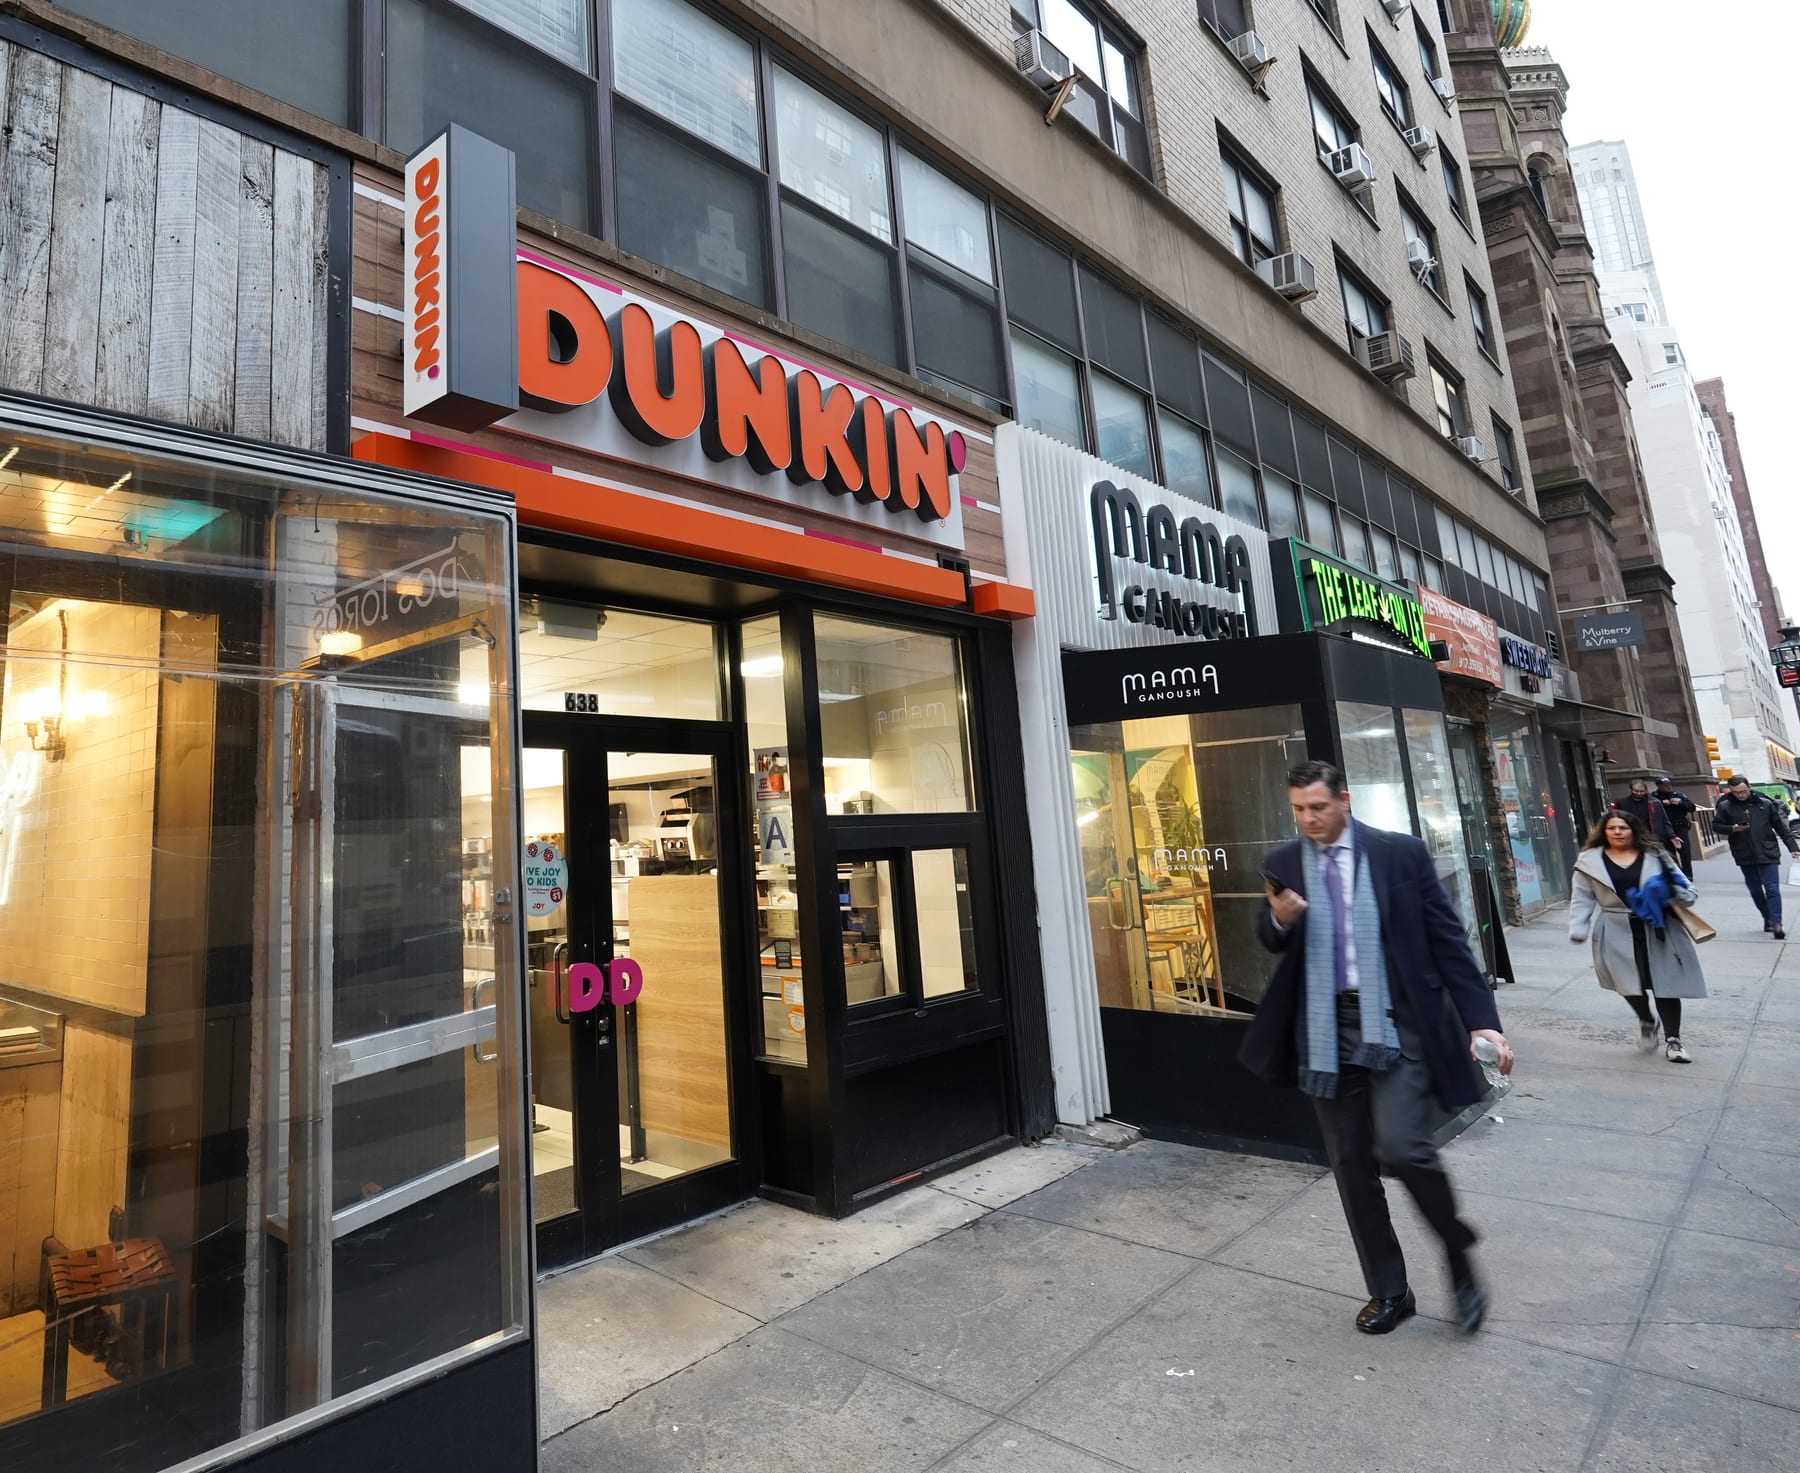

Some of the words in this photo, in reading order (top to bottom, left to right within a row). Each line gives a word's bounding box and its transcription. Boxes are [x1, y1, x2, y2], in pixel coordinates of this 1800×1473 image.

[415, 157, 440, 380] DUNKIN'
[517, 260, 967, 522] DUNKIN'
[1090, 480, 1259, 637] MAMA
[1123, 585, 1247, 639] GANOUSH
[1310, 558, 1348, 627] THE
[1344, 572, 1380, 621] LEAF
[1388, 592, 1409, 638] ON
[1404, 599, 1433, 660] LEX
[1582, 627, 1631, 639] Mulberry
[1122, 664, 1219, 704] MAMA
[1138, 688, 1201, 703] GANOUSH
[565, 692, 599, 712] 638
[765, 816, 788, 850] A
[526, 867, 540, 876] IVE
[542, 867, 561, 876] JOY
[1154, 848, 1228, 871] MAMA
[1167, 863, 1215, 871] GANOUSH
[527, 877, 535, 886] O
[537, 877, 557, 887] KIDS
